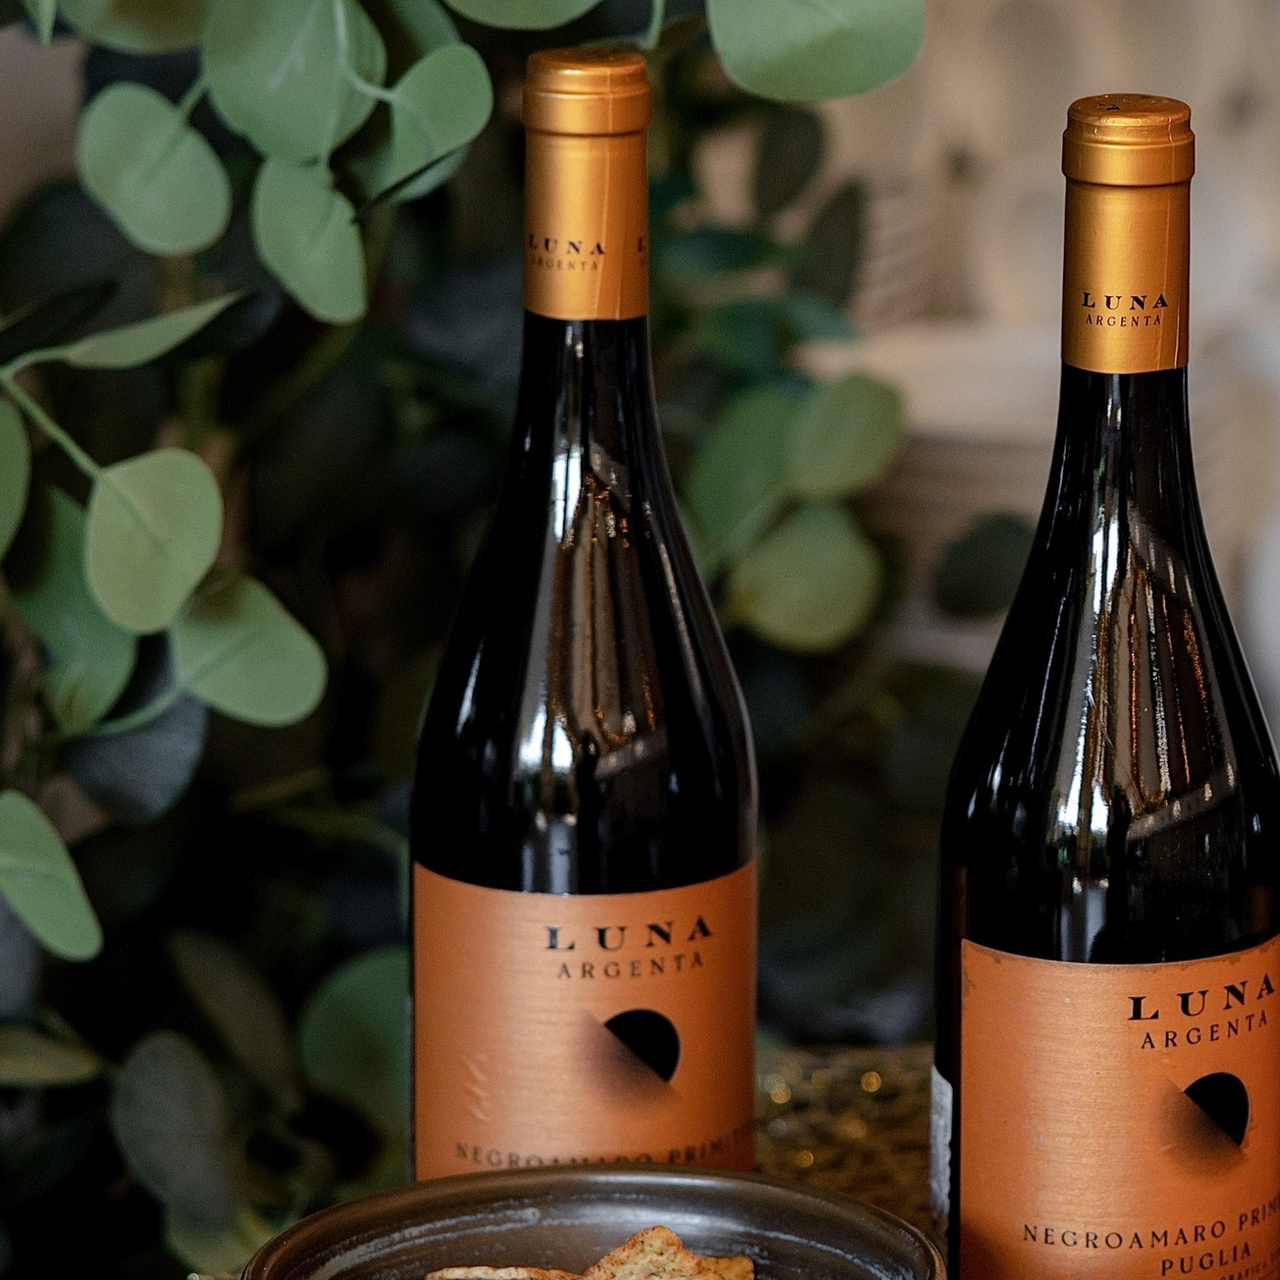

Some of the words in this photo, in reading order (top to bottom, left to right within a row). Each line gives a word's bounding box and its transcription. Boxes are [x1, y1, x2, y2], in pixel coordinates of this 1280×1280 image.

[529, 233, 606, 255] LUNA
[1082, 291, 1169, 311] LUNA
[1085, 313, 1161, 327] ARGENTA
[545, 915, 713, 951] LUNA
[557, 952, 705, 979] ARGENTA
[1127, 972, 1276, 1021] LUNA
[1141, 1010, 1269, 1049] ARGENTA
[1023, 1220, 1226, 1250] NEGROAMARO
[1161, 1241, 1251, 1276] PUGLIA
